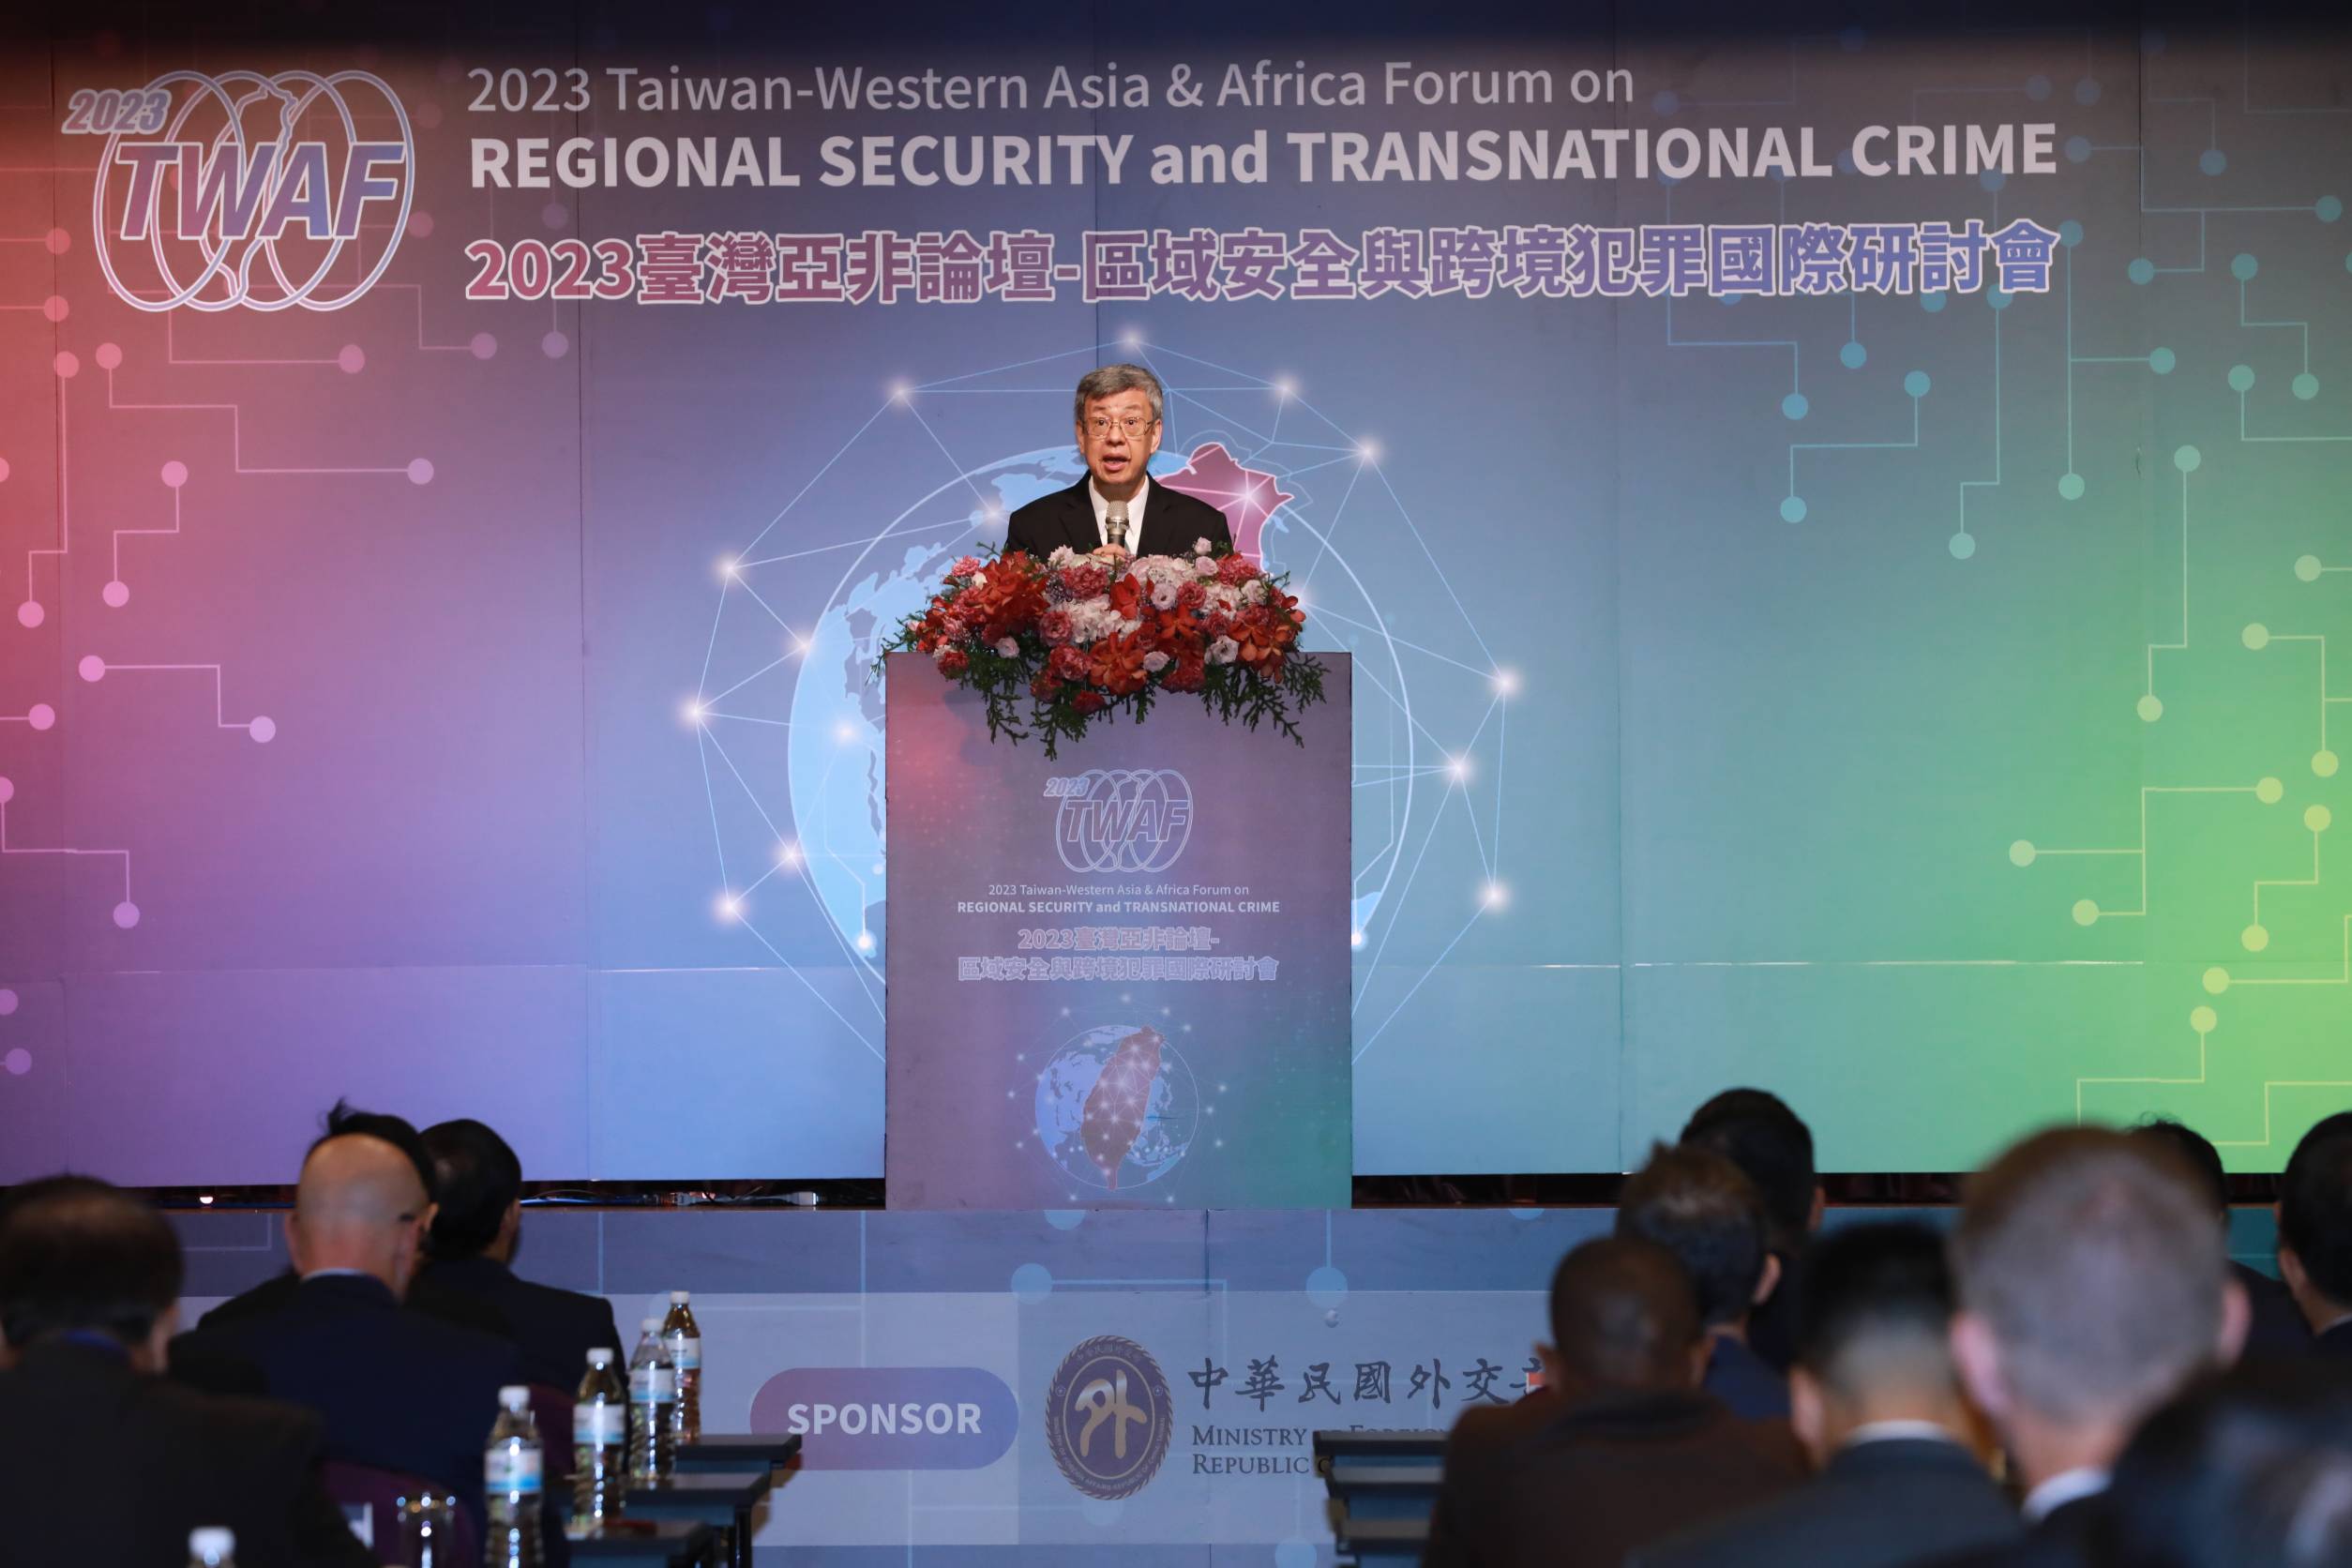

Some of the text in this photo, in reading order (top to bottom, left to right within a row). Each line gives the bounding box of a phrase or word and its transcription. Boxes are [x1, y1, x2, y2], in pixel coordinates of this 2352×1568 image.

[468, 60, 1634, 112] 2023 Taiwan-Western Asia & Africa Forum on
[62, 89, 173, 135] 2023
[471, 123, 2058, 188] REGIONAL SECURITY and TRANSNATIONAL CRIME
[115, 142, 408, 241] TWAF
[1043, 776, 1091, 797] 2023
[1065, 799, 1190, 842] TWAF
[957, 900, 1280, 913] REGIONAL SECURITY and TRANSNATIONAL CRIME
[988, 883, 1249, 896] 2023 Taiwan-Western Asia & Africa Forum on
[787, 1402, 983, 1435] SPONSOR
